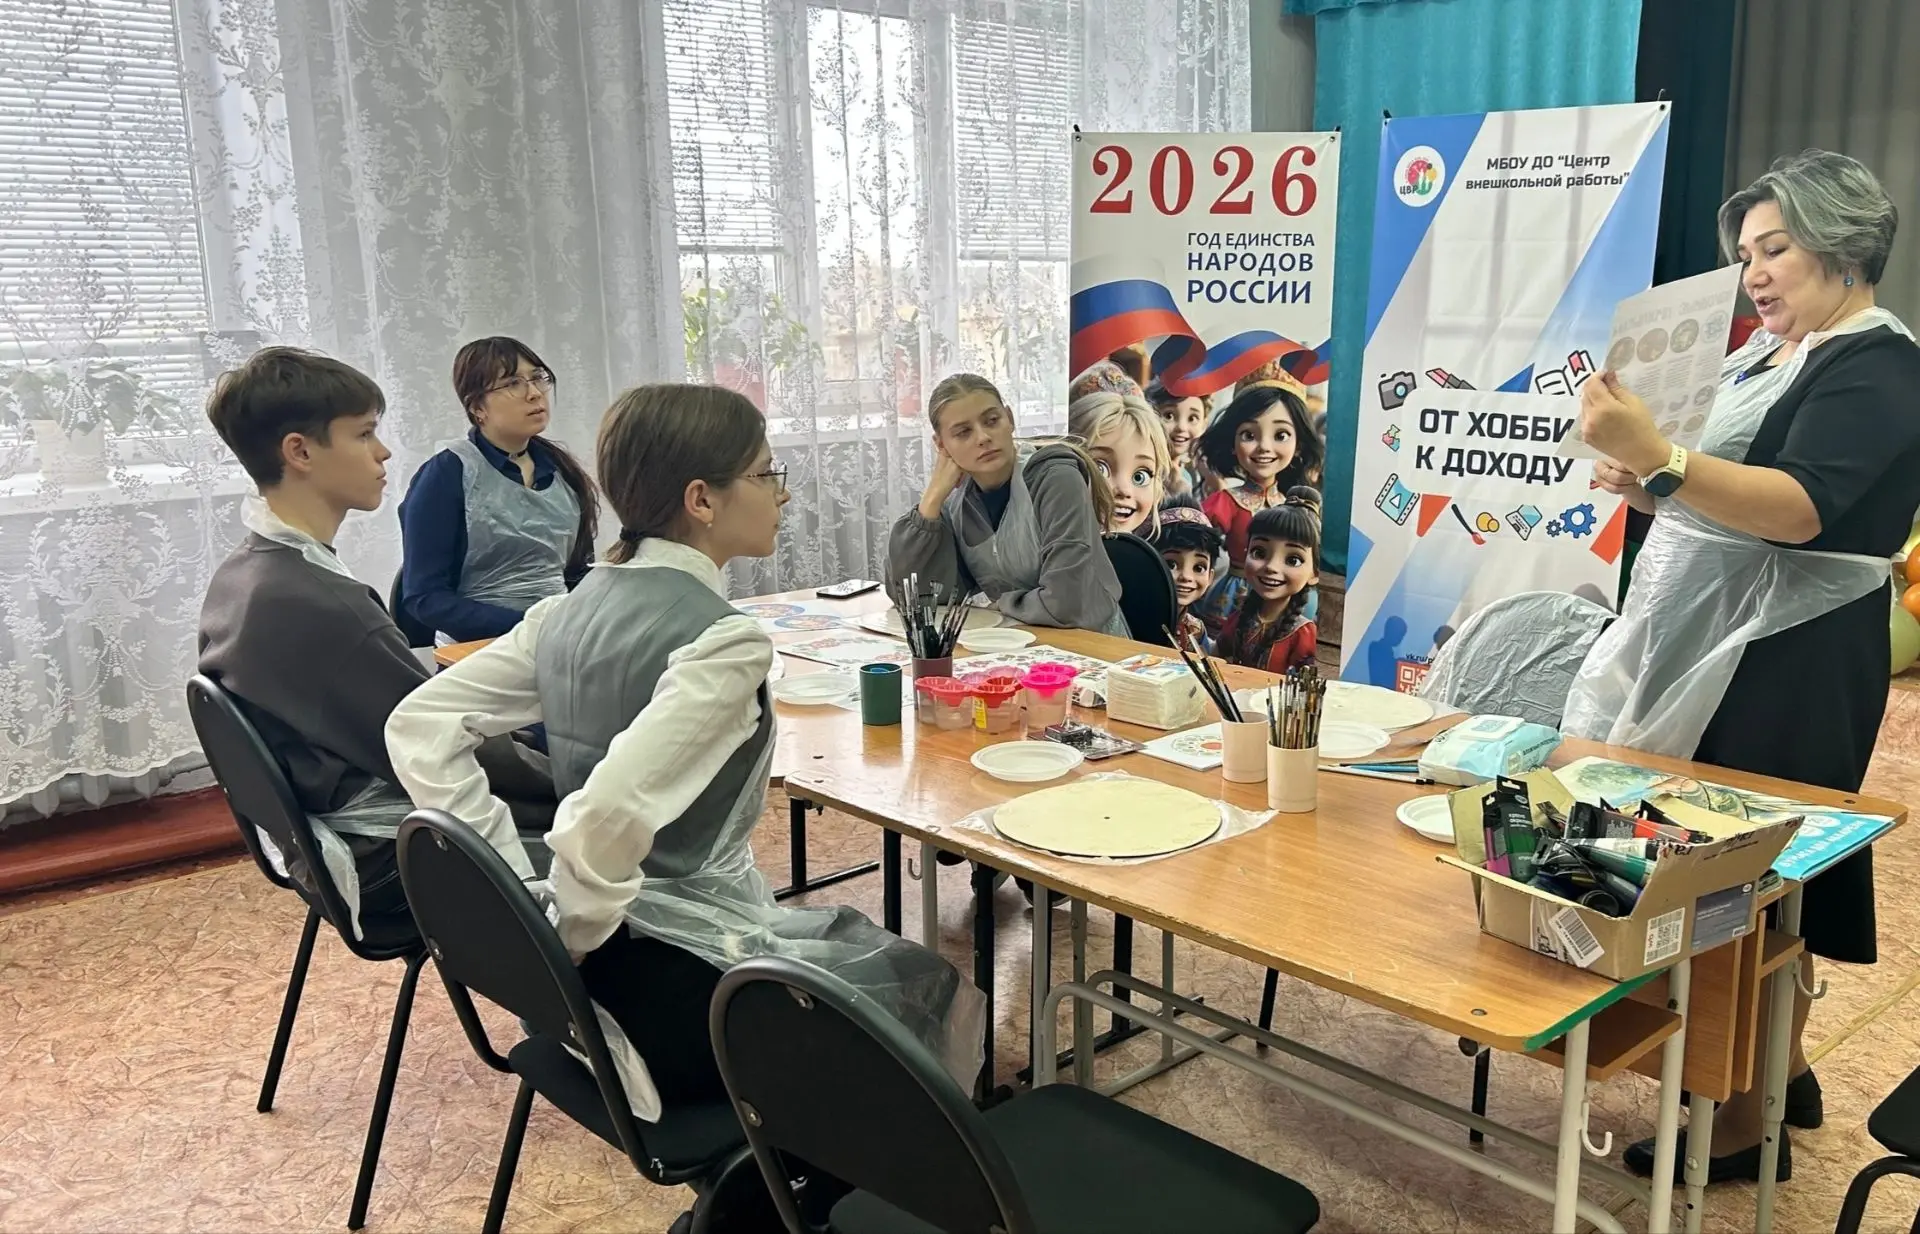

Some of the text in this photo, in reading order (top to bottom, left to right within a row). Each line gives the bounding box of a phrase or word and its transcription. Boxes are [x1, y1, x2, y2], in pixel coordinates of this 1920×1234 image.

[1486, 156, 1528, 171] МБОУ
[1531, 155, 1553, 170] ДО
[1089, 145, 1318, 217] 2026
[1399, 184, 1418, 196] ЦВР
[1465, 174, 1562, 190] внешкольной
[1187, 232, 1315, 249] ГОД ЕДИНСТВА
[1187, 252, 1314, 277] НАРОДОВ
[1187, 279, 1312, 304] РОССИИ
[1419, 408, 1575, 443] ОТ ХОББИ
[1415, 445, 1575, 486] К ДОХОДУ
